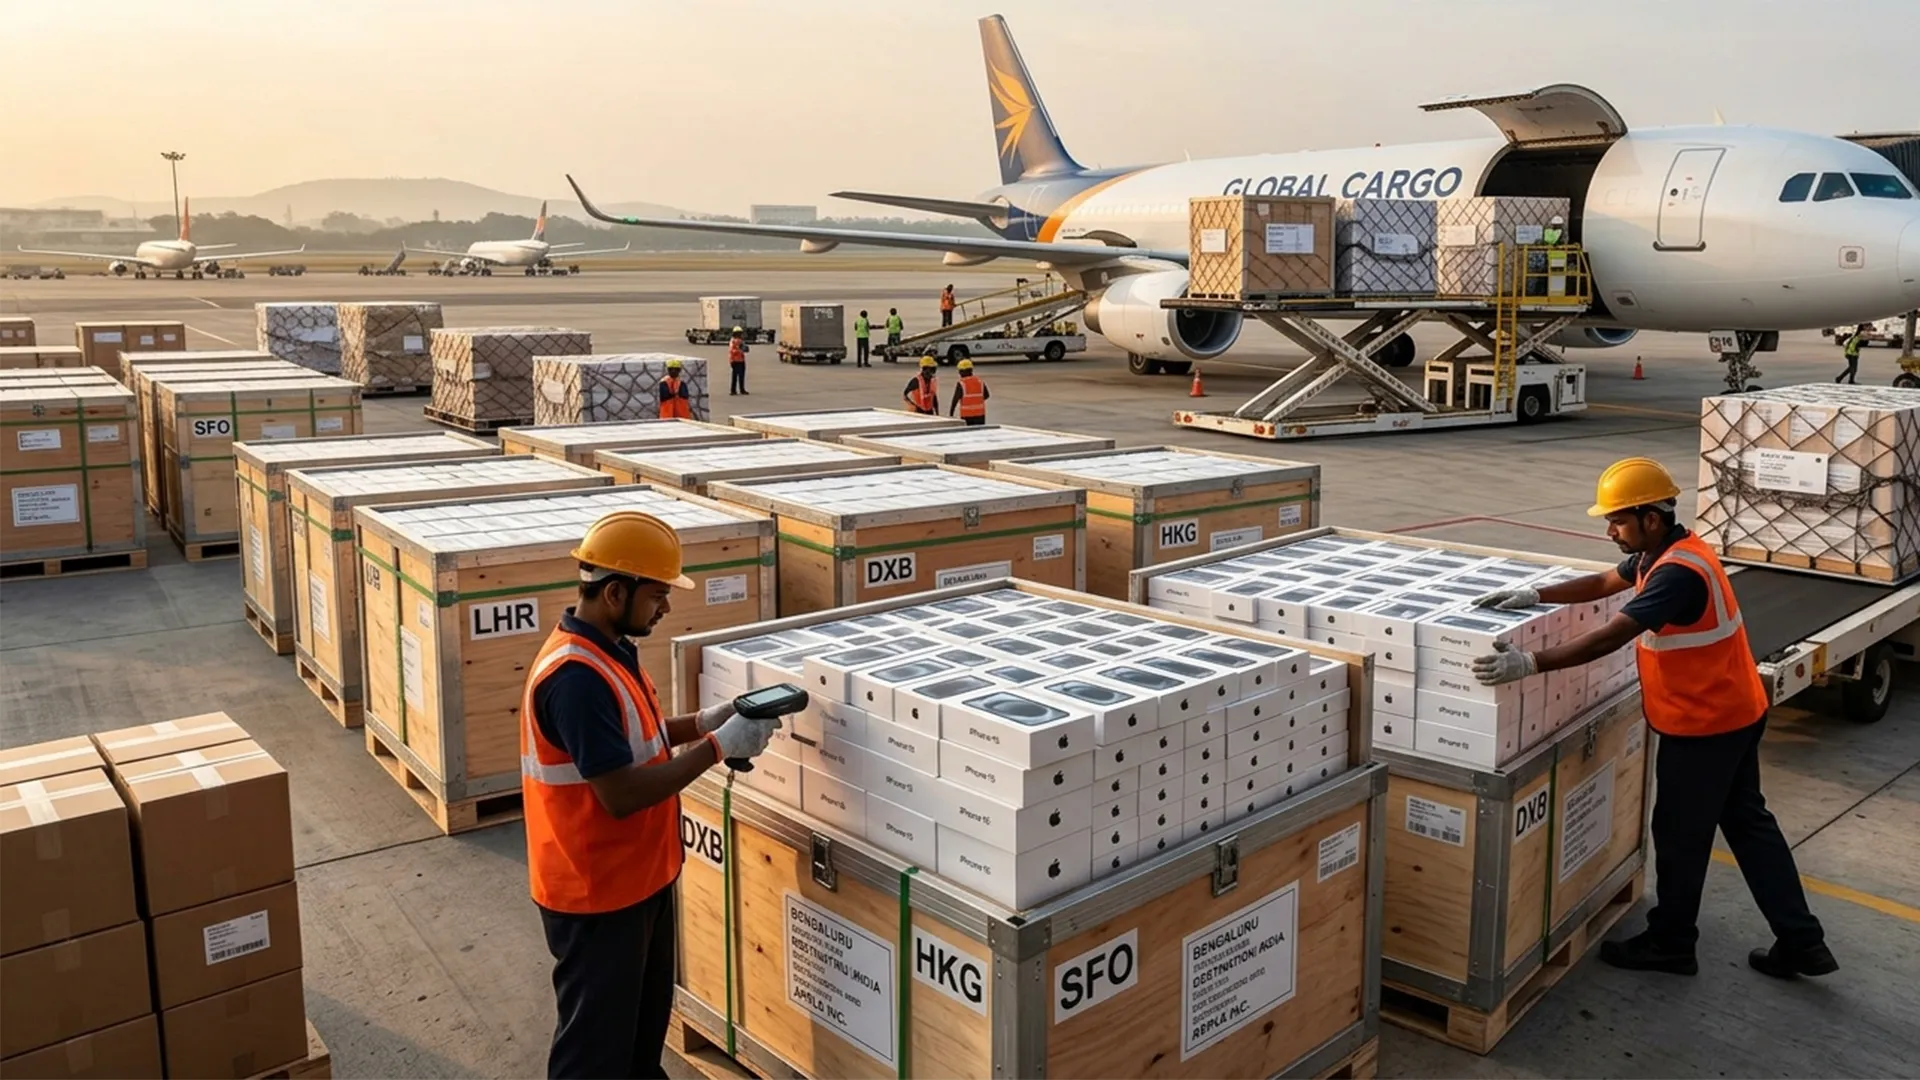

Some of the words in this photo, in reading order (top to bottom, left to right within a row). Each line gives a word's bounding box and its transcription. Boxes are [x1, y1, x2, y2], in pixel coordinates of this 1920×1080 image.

[1223, 174, 1331, 197] GLOBAL
[1342, 167, 1463, 199] CARGO
[194, 420, 230, 435] SFO
[1161, 522, 1197, 546] HKG
[867, 557, 913, 583] DXB
[474, 602, 536, 635] LHR
[682, 815, 724, 865] DXB
[1193, 916, 1259, 960] BENGALURU
[916, 937, 982, 1004] HKG
[1060, 943, 1133, 1010] SFO
